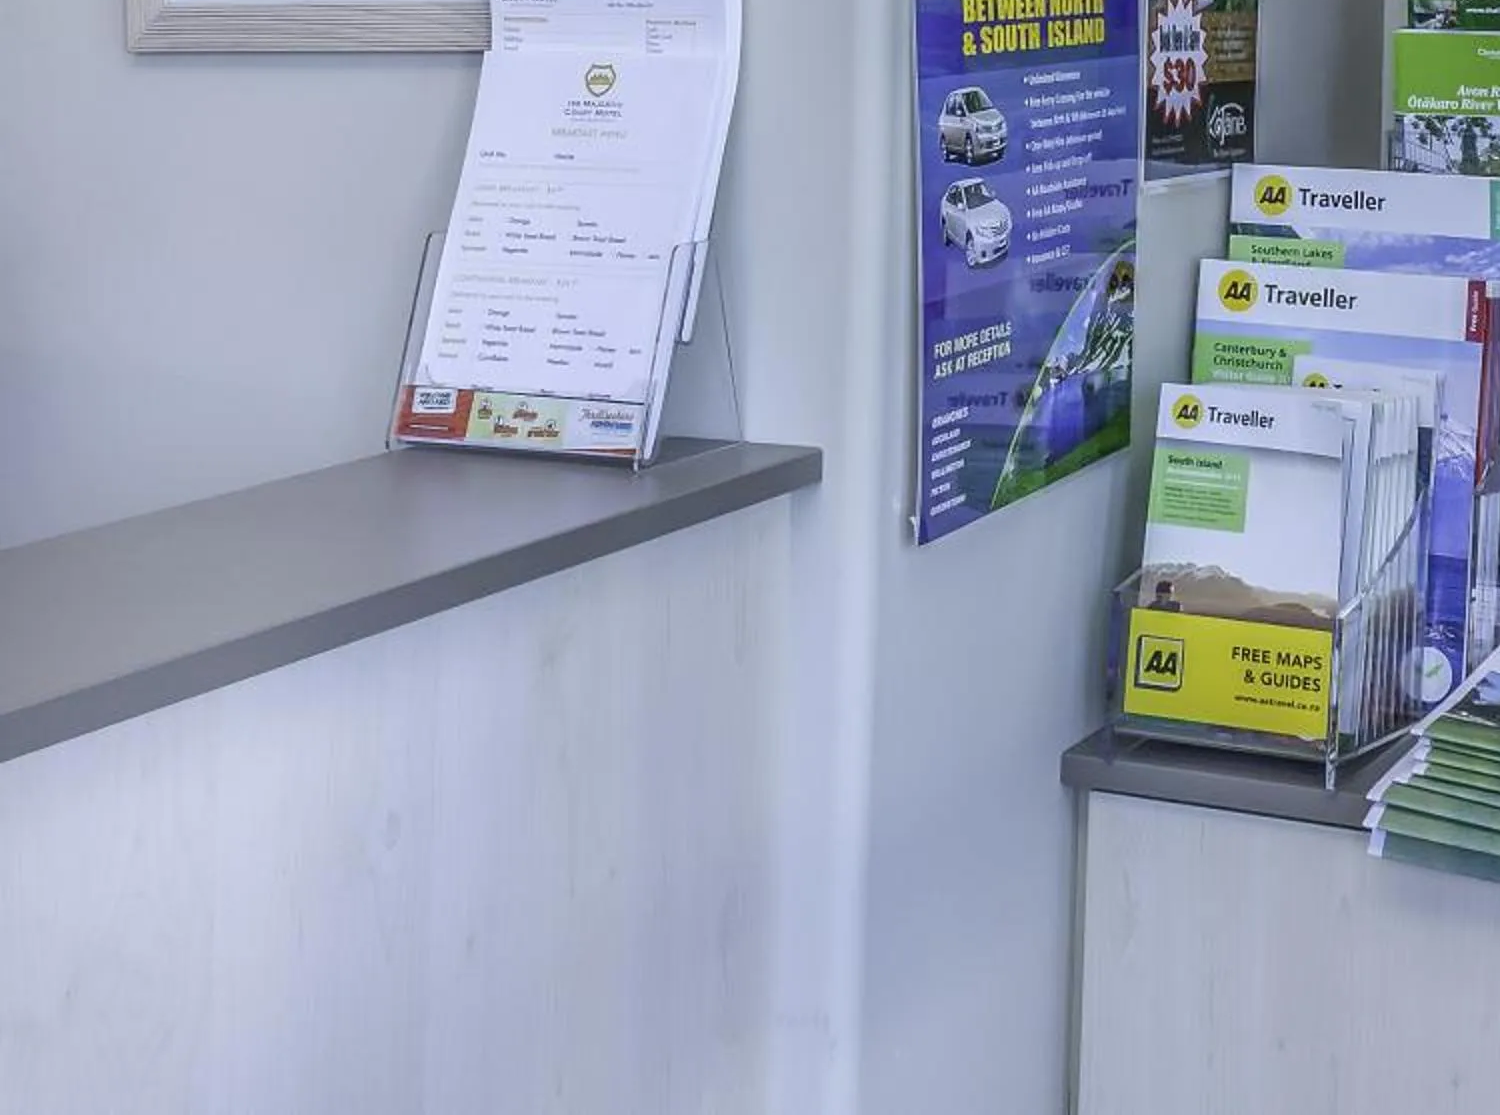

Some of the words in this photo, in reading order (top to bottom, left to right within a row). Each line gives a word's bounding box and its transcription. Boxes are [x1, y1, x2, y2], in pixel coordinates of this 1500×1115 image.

[963, 28, 976, 57] &
[980, 23, 1042, 55] SOUTH
[1048, 18, 1105, 49] ISLAND
[1250, 244, 1299, 260] Southern
[1303, 247, 1334, 261] Lakes
[934, 362, 953, 379] ASK
[955, 356, 966, 372] AT
[967, 341, 1011, 369] RECEPTION
[1212, 355, 1284, 371] Christchurch
[1175, 404, 1199, 420] AA
[1207, 406, 1275, 430] Traveller
[1231, 645, 1272, 665] FREE
[1275, 650, 1323, 671] MAPS
[1243, 670, 1256, 685] &
[1260, 672, 1322, 693] GUIDES
